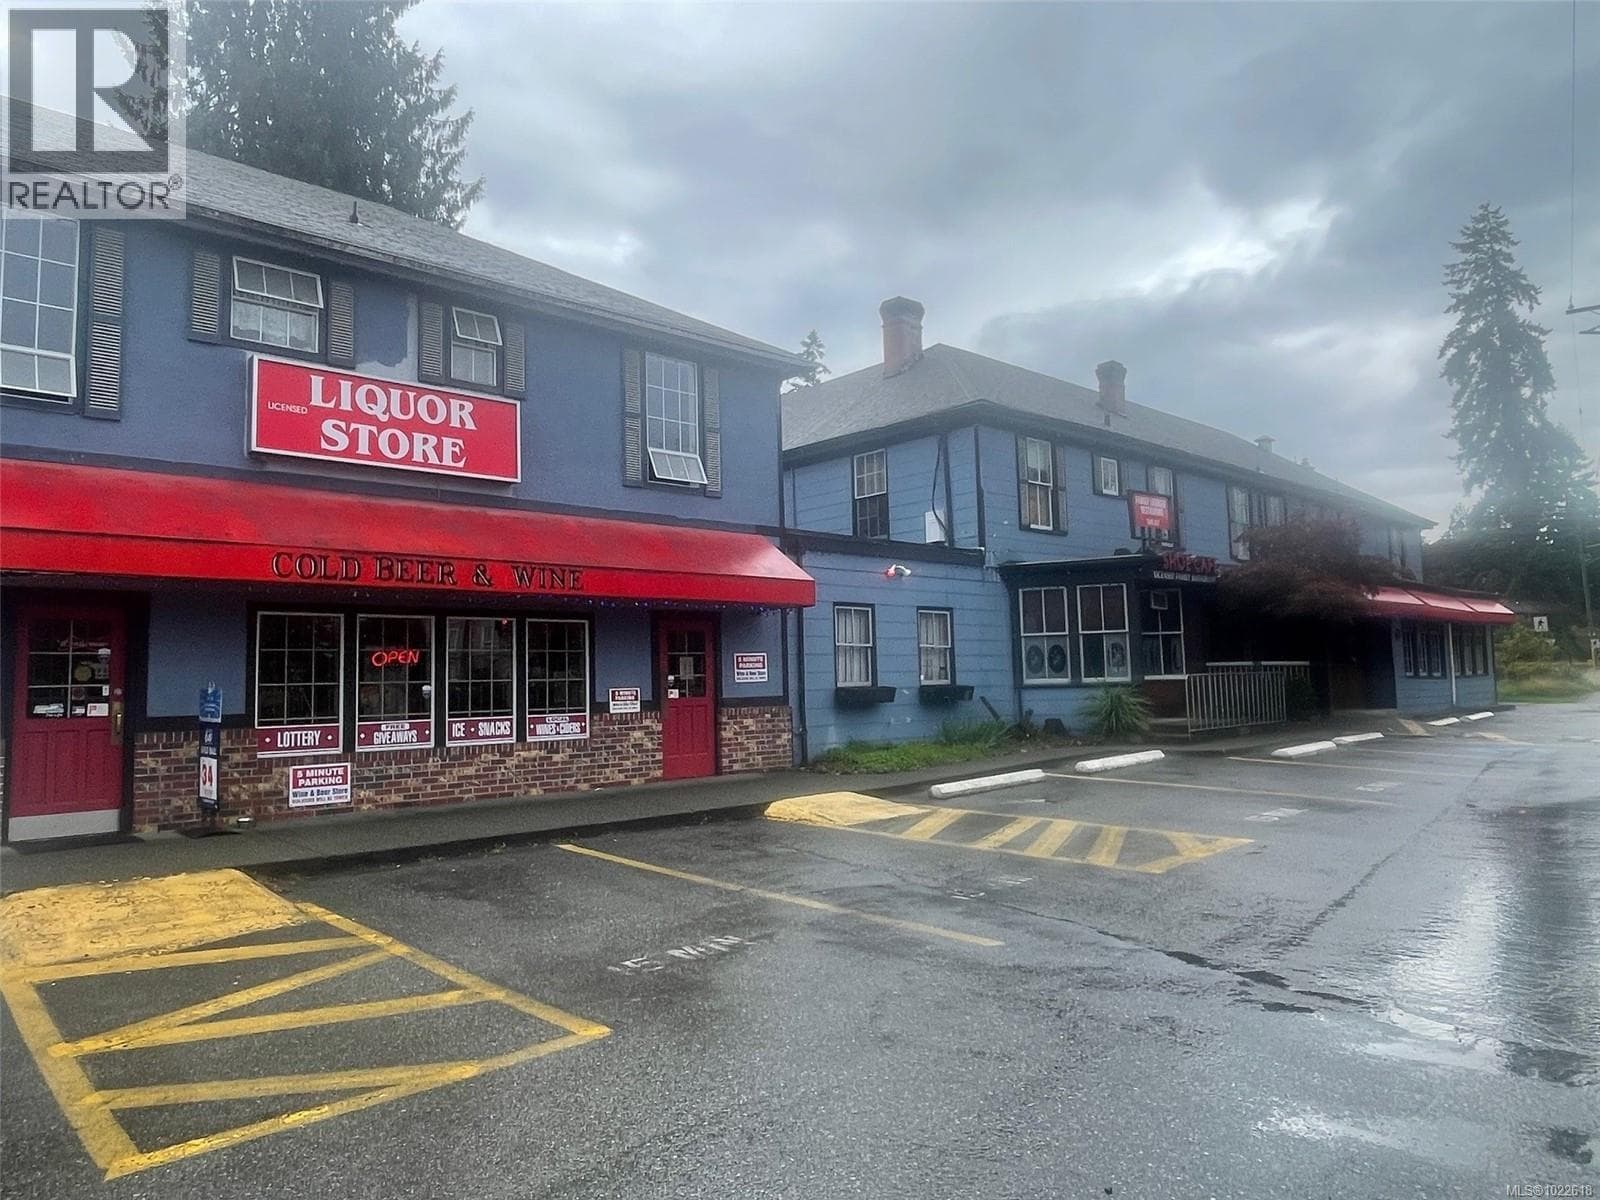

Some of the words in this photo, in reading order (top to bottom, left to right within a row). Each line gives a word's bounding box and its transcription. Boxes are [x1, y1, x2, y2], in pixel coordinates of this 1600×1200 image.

[267, 401, 308, 415] LICENSED
[309, 374, 478, 431] LIQUOR
[320, 418, 467, 468] STORE
[271, 552, 362, 581] COLD
[374, 555, 458, 586] BEER
[472, 563, 493, 587] &
[511, 564, 585, 592] WINE
[371, 650, 420, 667] OPEN
[373, 729, 418, 745] GIVEAWAYS
[452, 722, 465, 737] ICE
[478, 721, 511, 737] SNACKS
[277, 730, 321, 748] LOTTERY
[306, 767, 345, 777] MINUTE
[298, 776, 343, 787] PARKING
